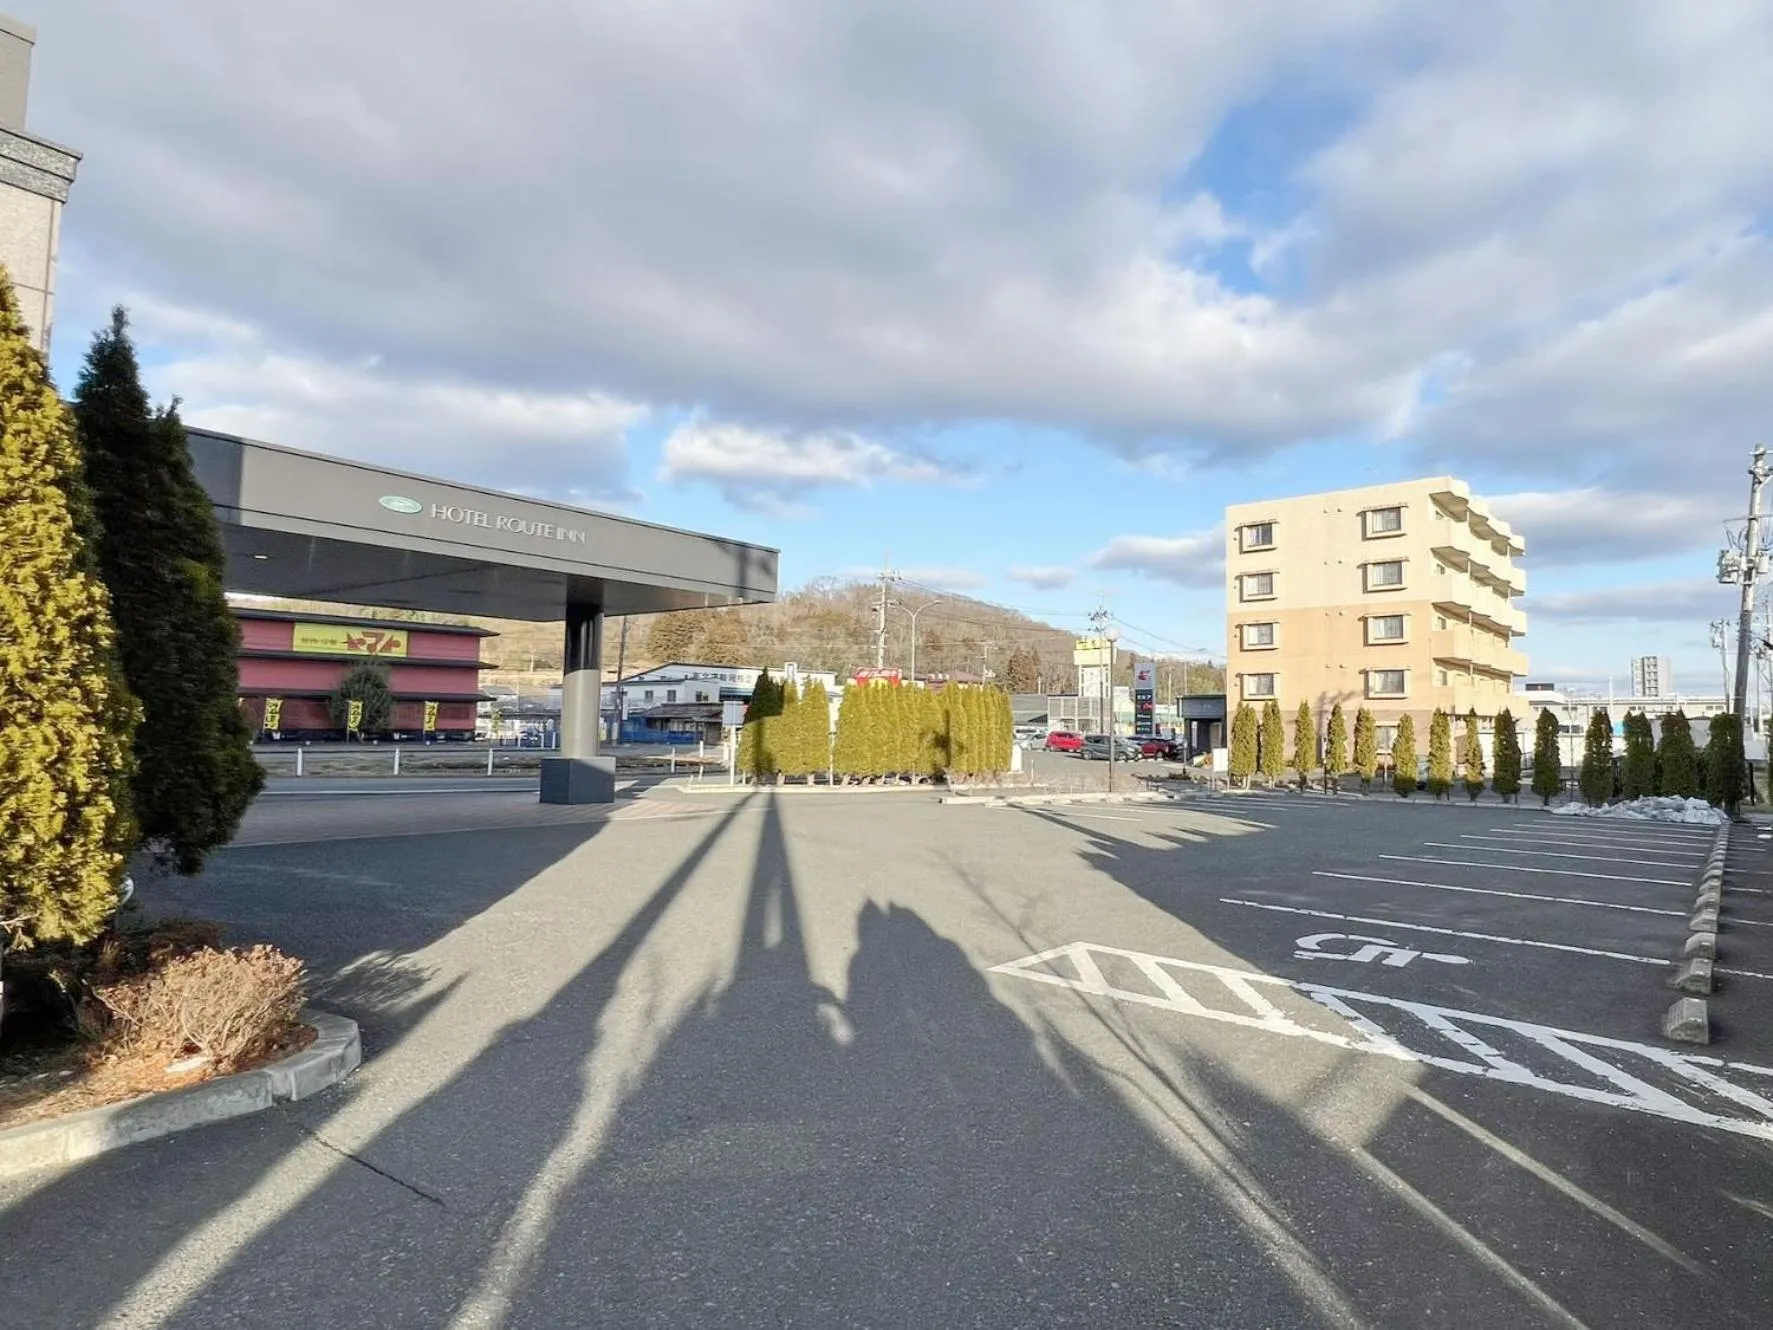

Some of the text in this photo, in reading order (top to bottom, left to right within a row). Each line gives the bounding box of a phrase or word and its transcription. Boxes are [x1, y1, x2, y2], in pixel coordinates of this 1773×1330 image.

[431, 503, 587, 545] HOTEL ROUTE INN
